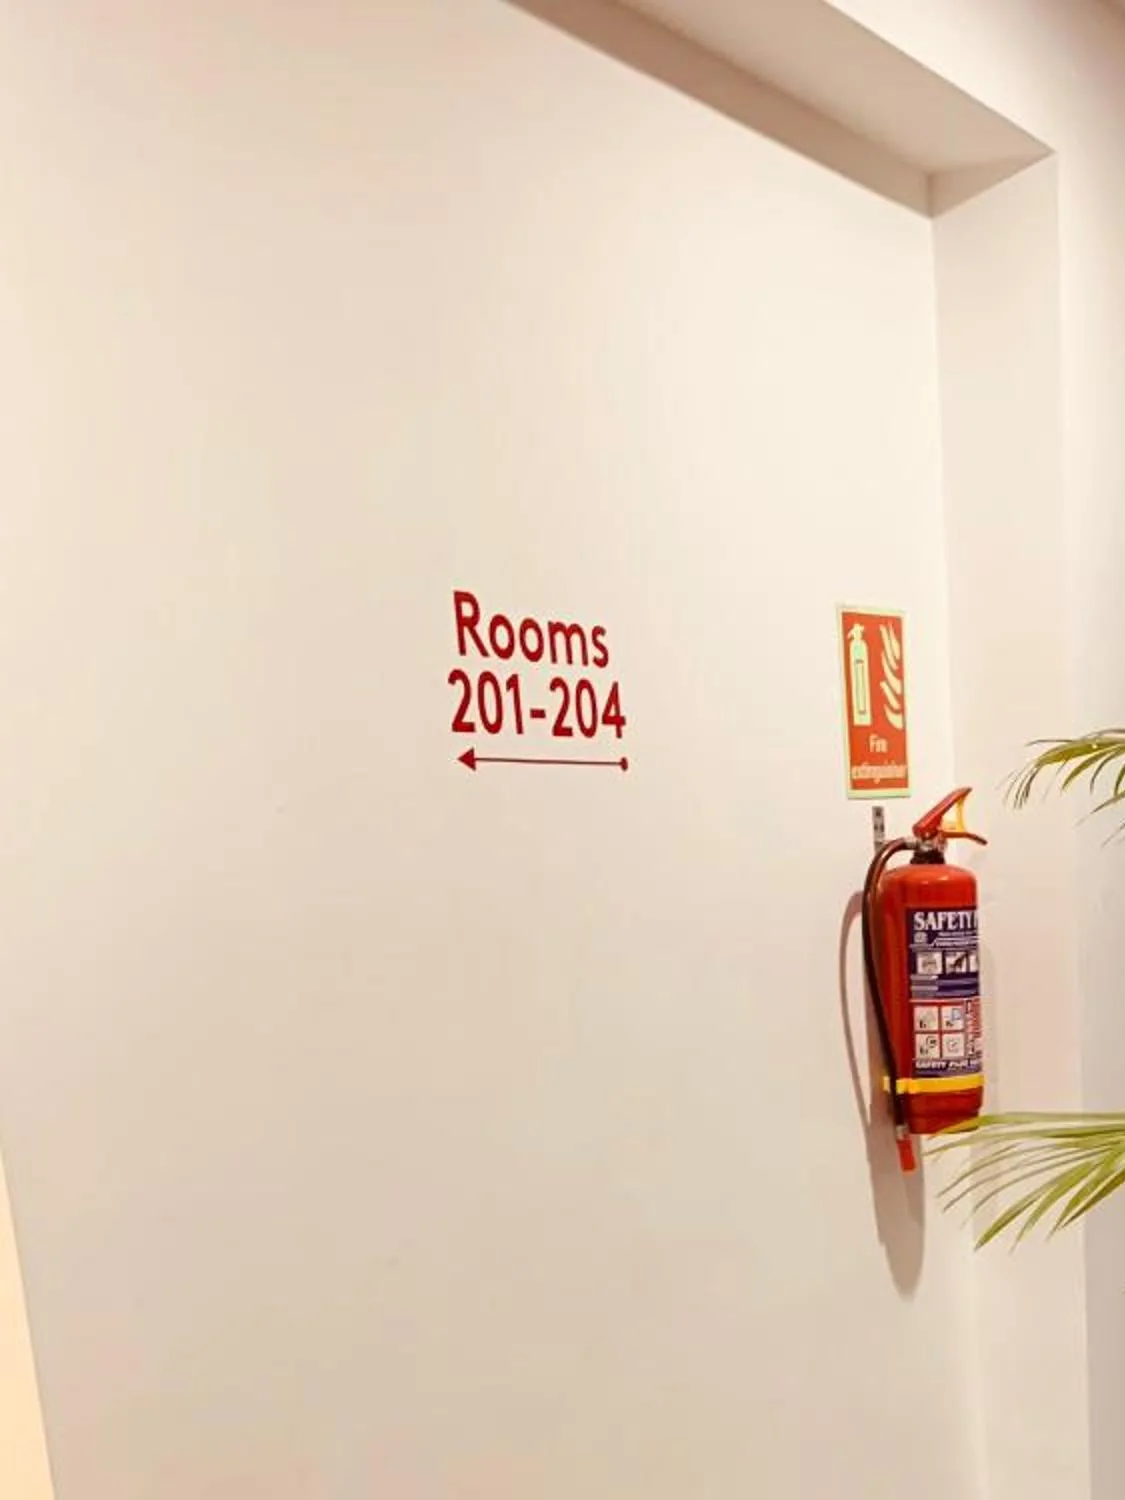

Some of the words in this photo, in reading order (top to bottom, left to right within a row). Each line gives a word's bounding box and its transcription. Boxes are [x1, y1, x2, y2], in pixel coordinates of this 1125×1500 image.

[453, 590, 609, 668] Rooms
[448, 669, 626, 739] 201-204
[913, 911, 973, 930] SAFETY
